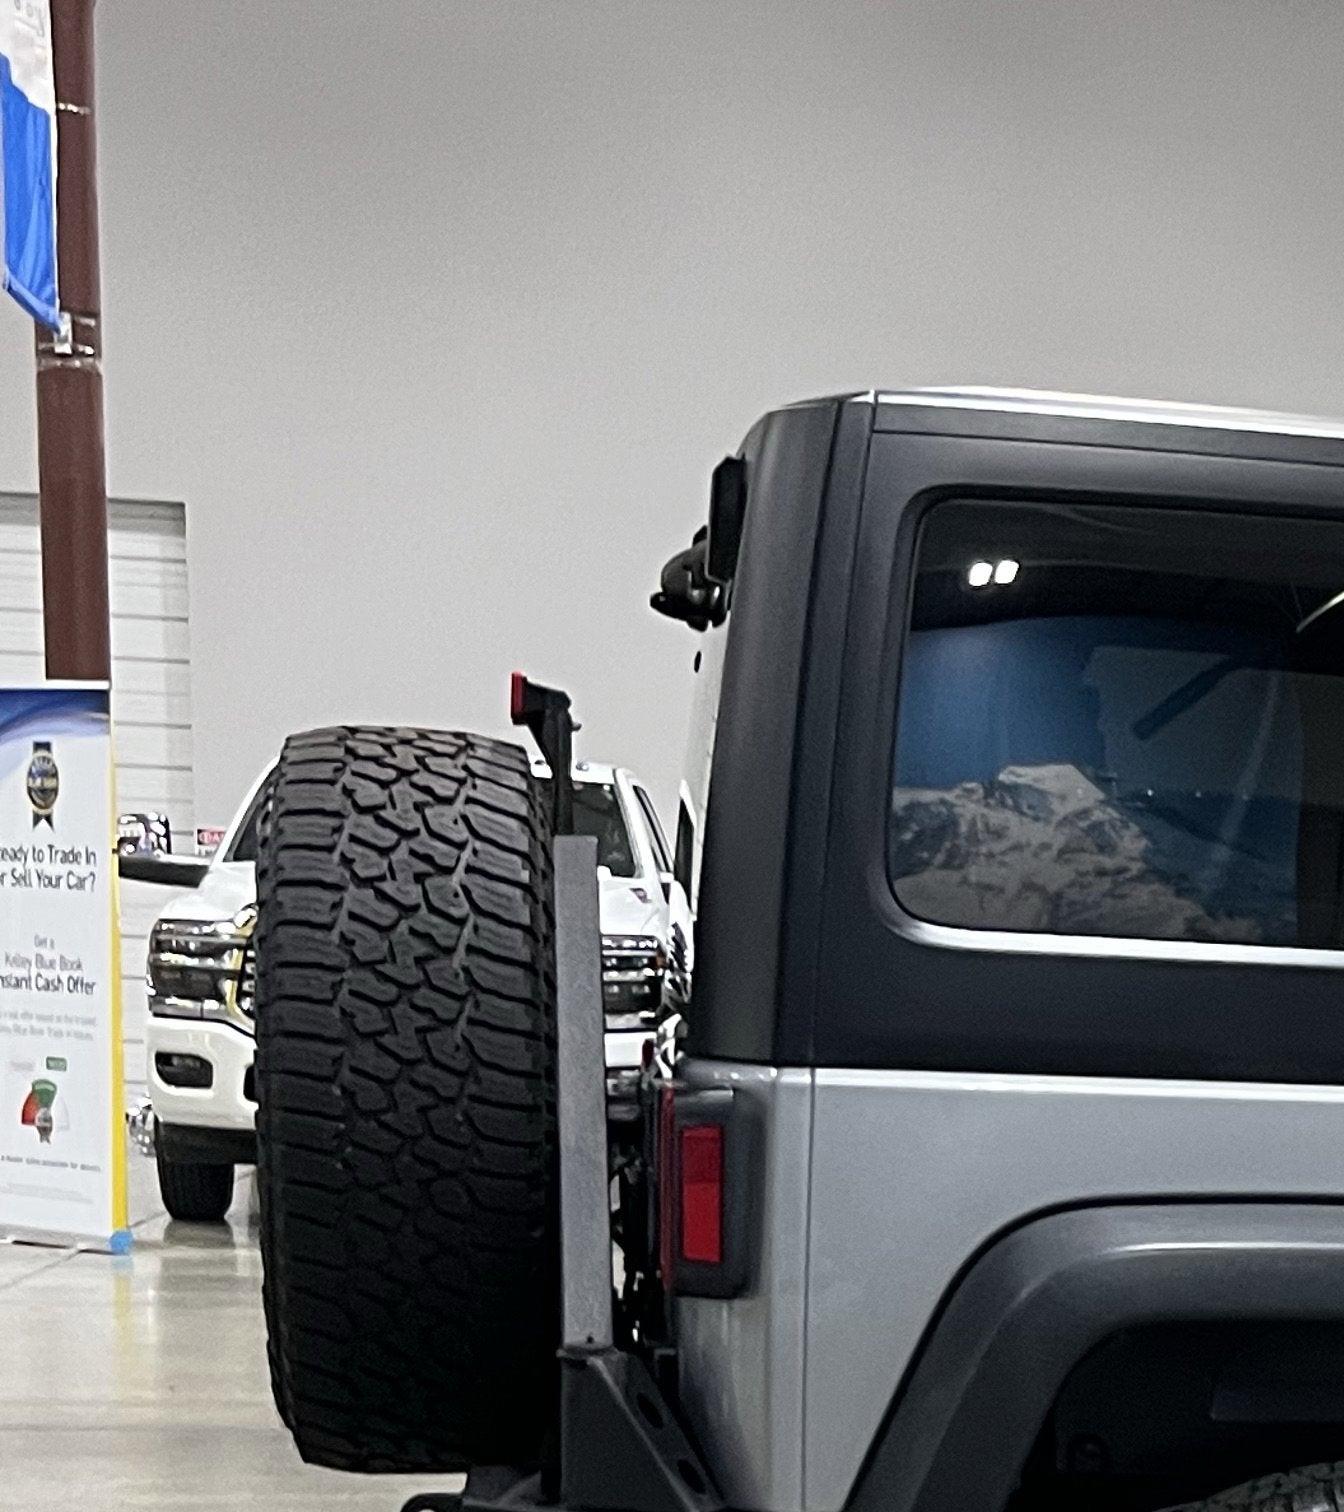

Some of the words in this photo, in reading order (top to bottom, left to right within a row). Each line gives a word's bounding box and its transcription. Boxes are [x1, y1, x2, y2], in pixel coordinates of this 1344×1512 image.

[32, 845, 44, 863] to
[47, 843, 82, 864] Trade
[85, 846, 97, 867] In
[11, 867, 33, 888] Sell
[35, 869, 63, 889] Your
[66, 870, 96, 893] Car?
[35, 971, 64, 992] Cash
[67, 975, 97, 995] Offer
